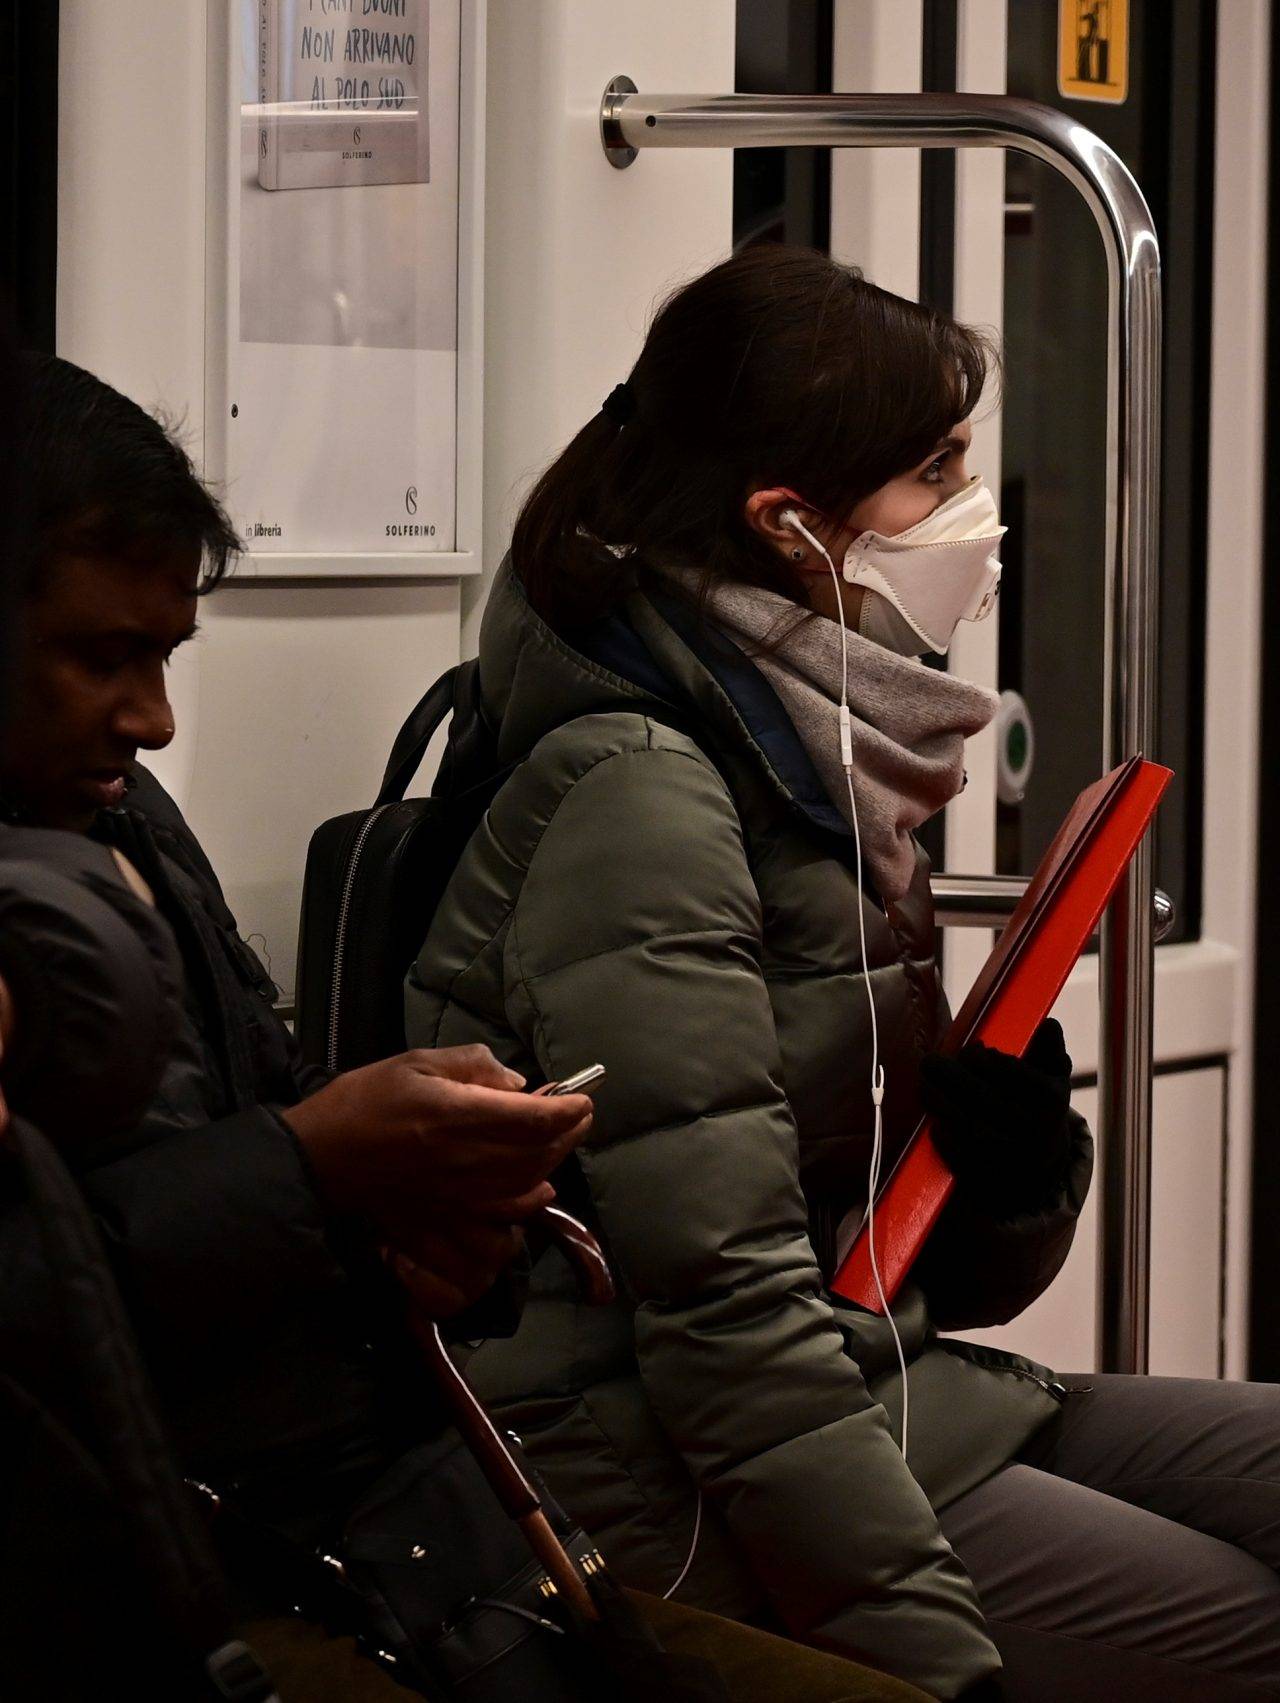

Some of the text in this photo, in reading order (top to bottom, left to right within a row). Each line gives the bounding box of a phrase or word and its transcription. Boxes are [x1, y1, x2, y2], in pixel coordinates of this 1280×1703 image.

[301, 26, 415, 65] NON ARRIVANO
[311, 75, 405, 110] AL POLO SUD
[245, 522, 282, 537] in libreria
[385, 524, 436, 537] SOLFERINO
